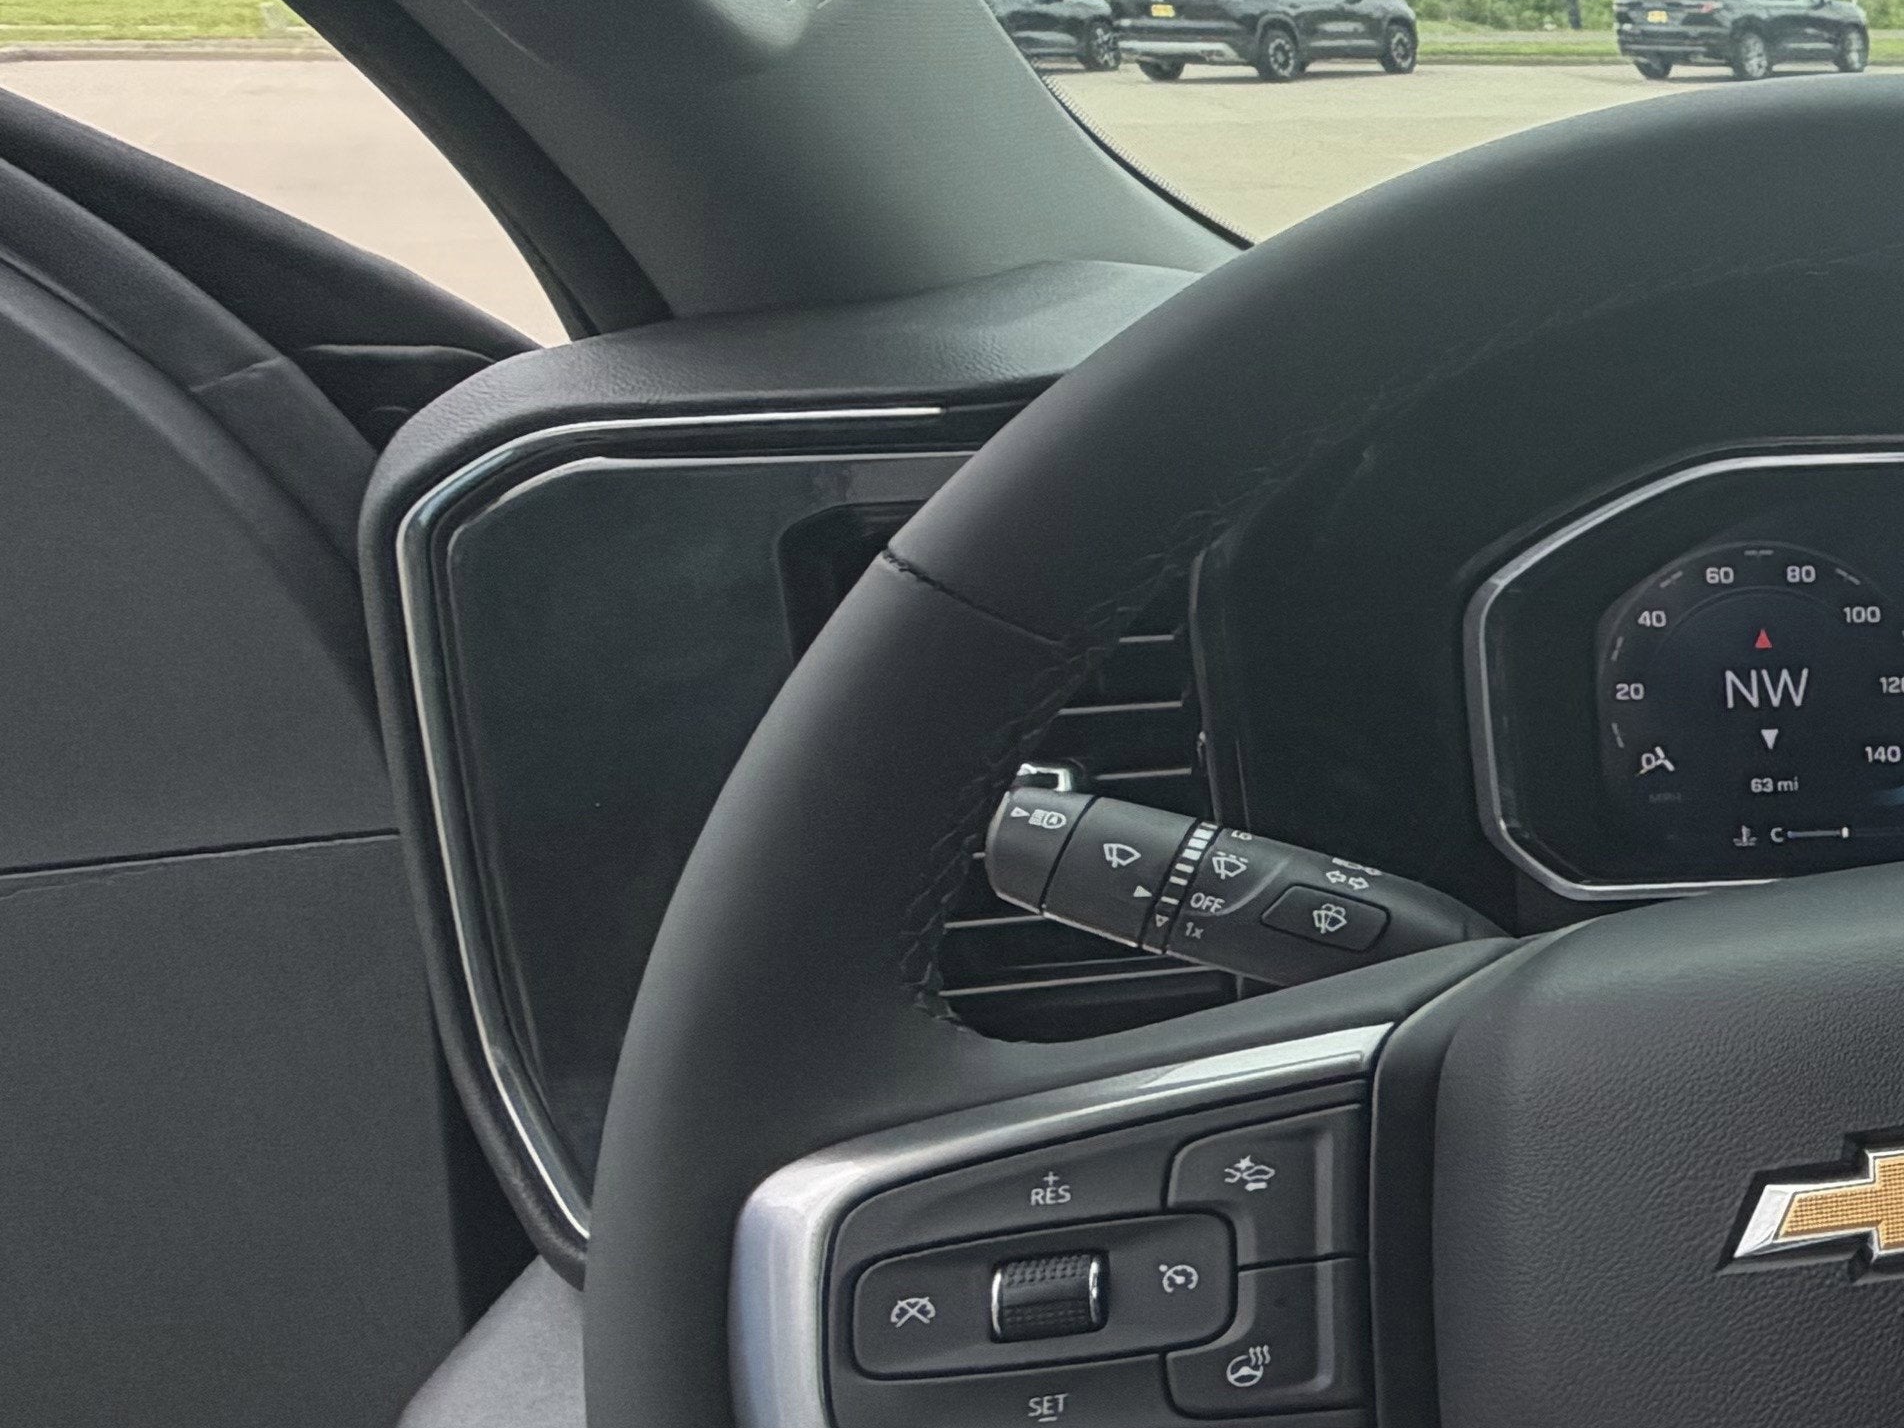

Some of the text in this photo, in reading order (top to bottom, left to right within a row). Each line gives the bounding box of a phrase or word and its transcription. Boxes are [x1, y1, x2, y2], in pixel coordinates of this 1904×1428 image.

[1705, 566, 1735, 585] 60
[1785, 564, 1817, 584] 80
[1637, 610, 1668, 628] 40
[1842, 605, 1882, 624] 100
[1615, 682, 1646, 701] 20
[1724, 668, 1810, 709] NW
[1864, 745, 1902, 764] 140
[1750, 776, 1799, 793] 63 mi
[1769, 826, 1785, 843] C
[1189, 891, 1226, 913] OFF
[1185, 921, 1205, 940] 1x
[1030, 1185, 1072, 1206] RES
[1027, 1392, 1069, 1417] SET
